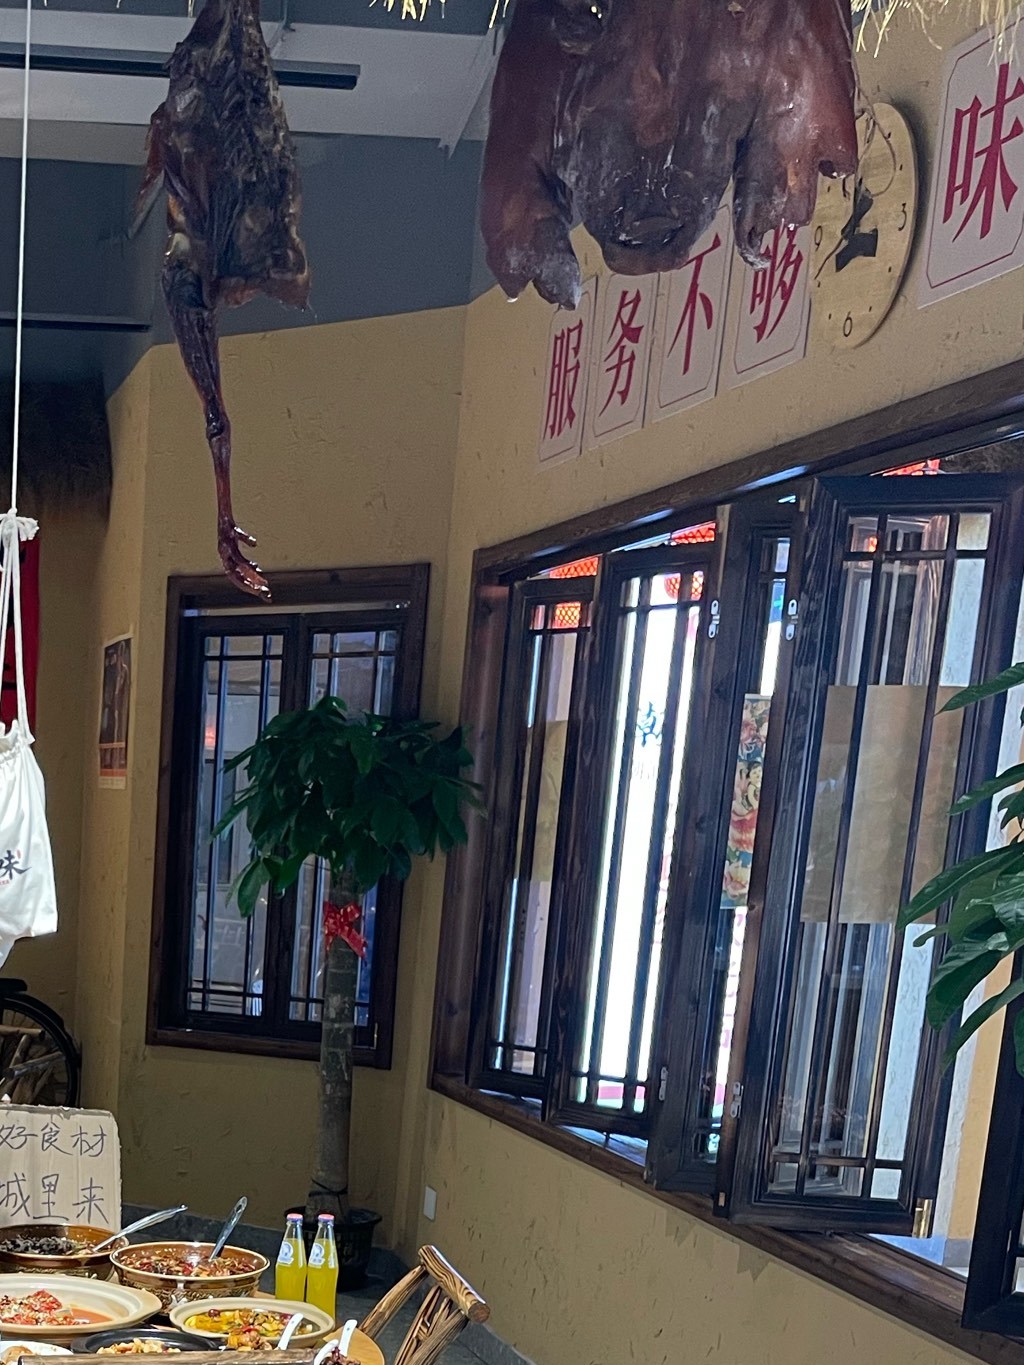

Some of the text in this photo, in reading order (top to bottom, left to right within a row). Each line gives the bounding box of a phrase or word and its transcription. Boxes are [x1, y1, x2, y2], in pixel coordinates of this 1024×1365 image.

[942, 61, 1024, 243] 味
[897, 202, 908, 232] 3
[807, 225, 823, 252] 9
[842, 311, 854, 338] 6
